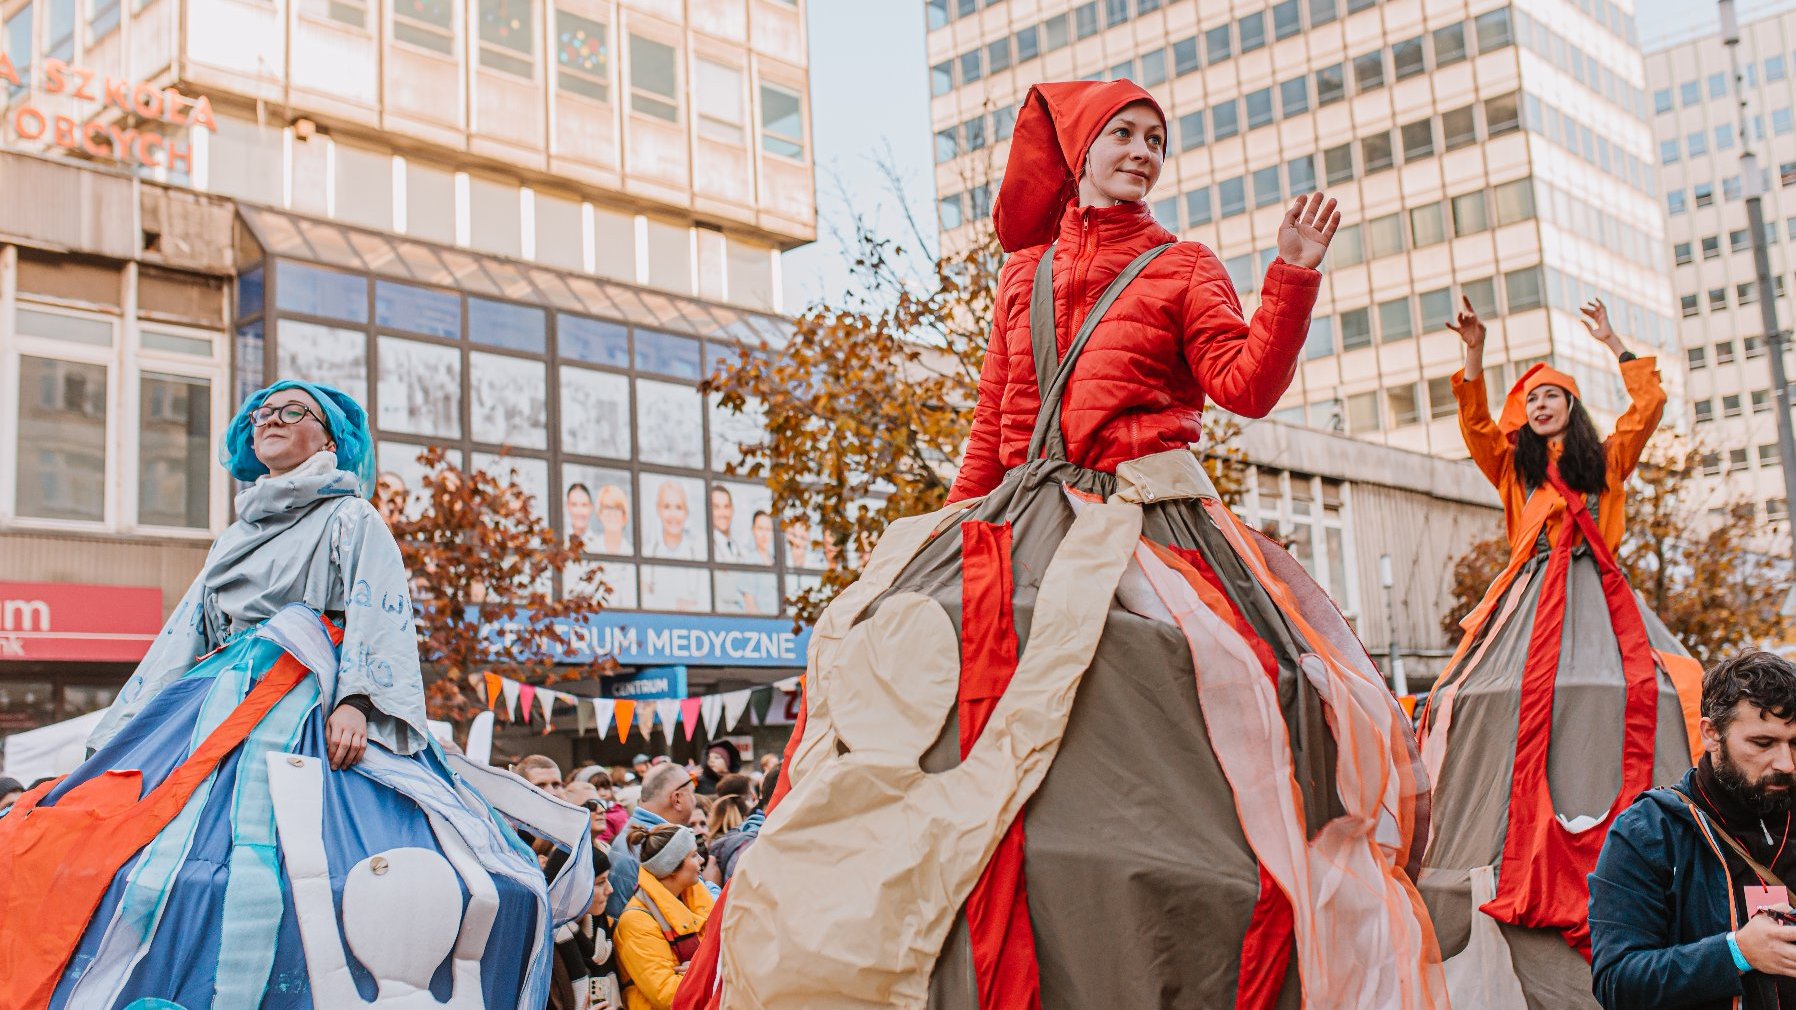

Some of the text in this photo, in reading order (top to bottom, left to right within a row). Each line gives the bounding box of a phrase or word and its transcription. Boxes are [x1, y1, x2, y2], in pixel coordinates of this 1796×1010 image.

[45, 57, 218, 133] SZKOŁA
[16, 106, 192, 174] OBCYCH
[479, 621, 797, 659] CENTRUM MEDYCZNE
[612, 678, 668, 696] CENTRUM
